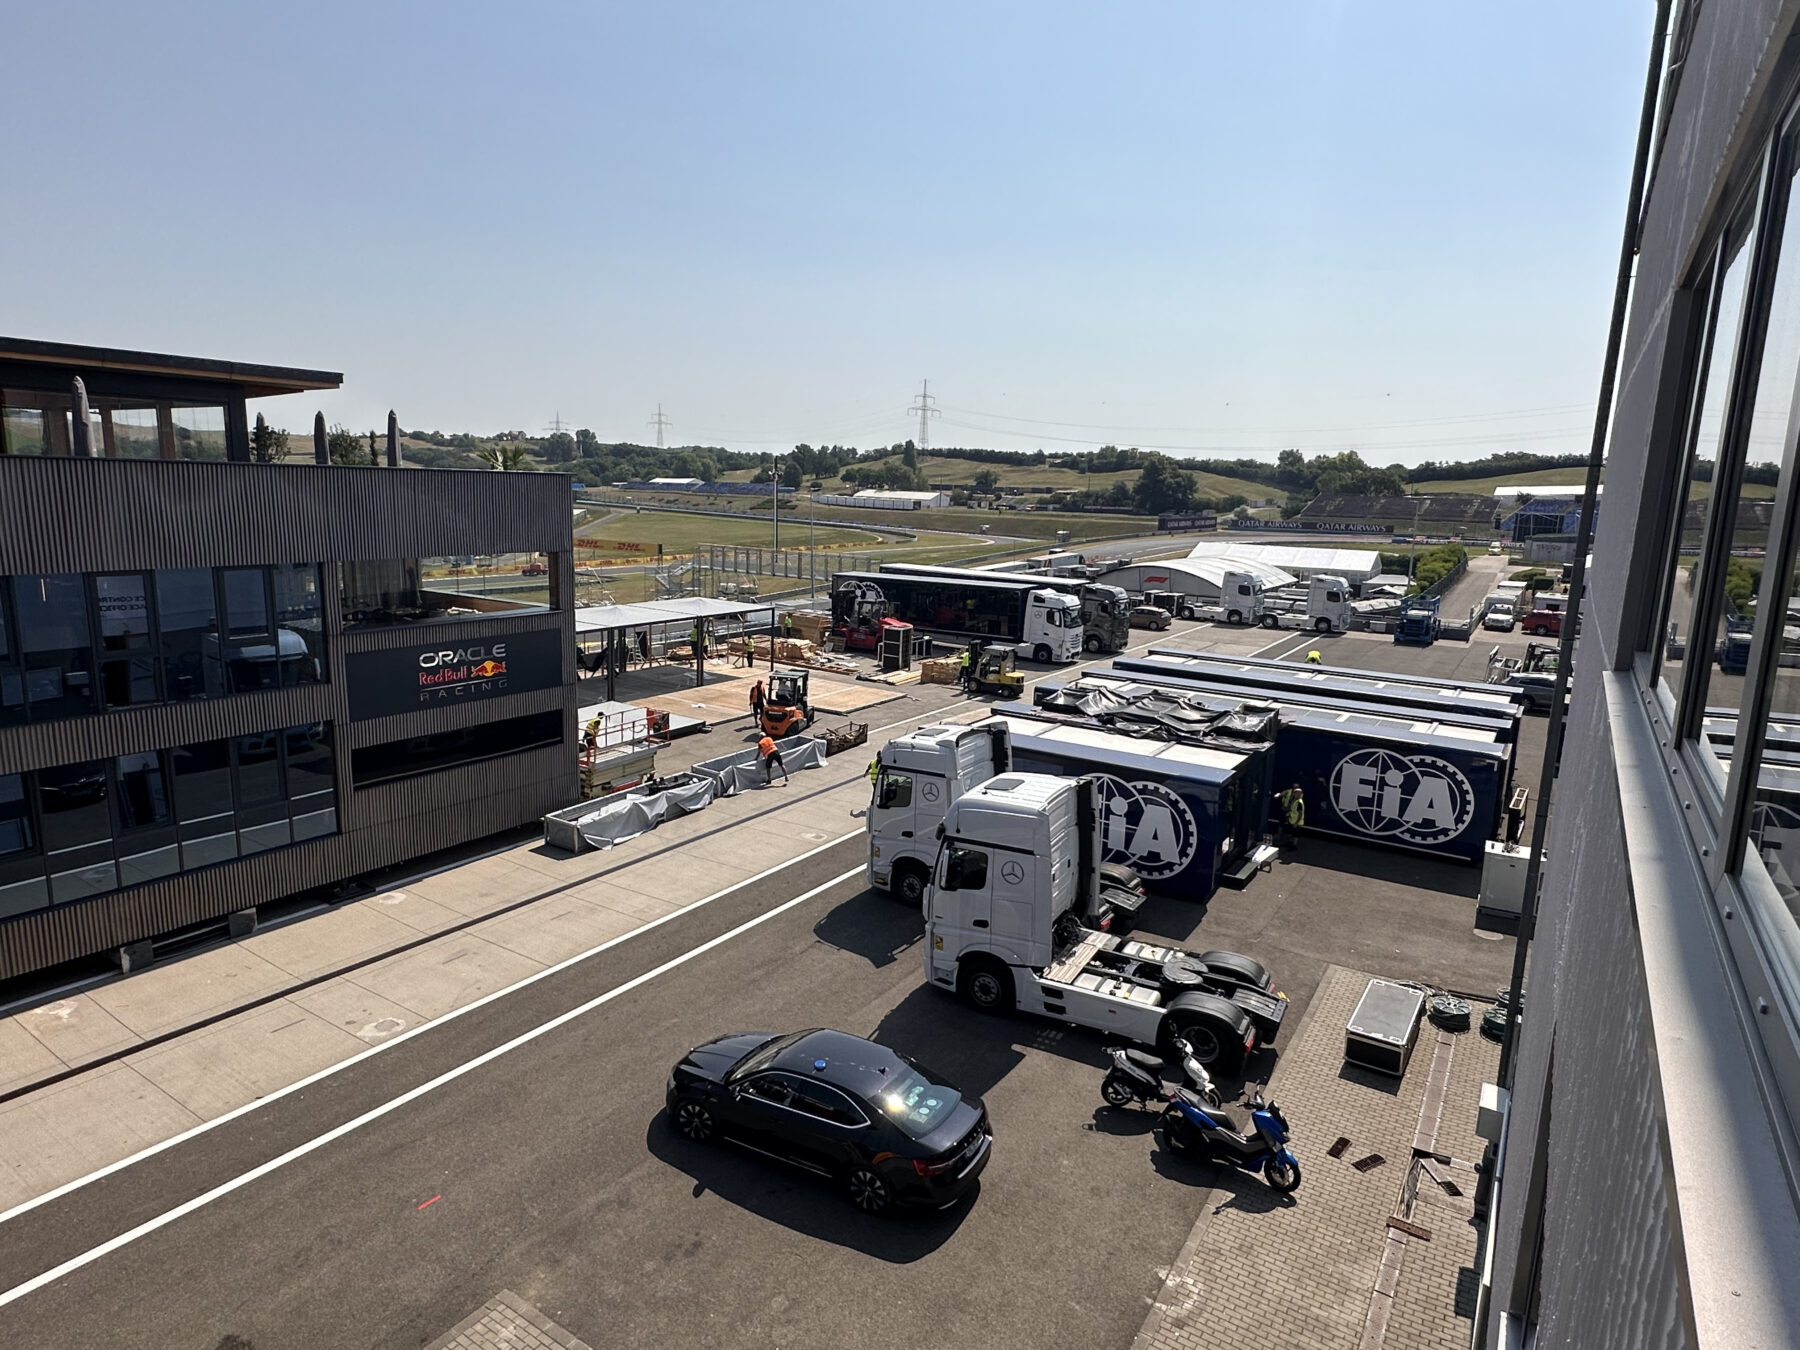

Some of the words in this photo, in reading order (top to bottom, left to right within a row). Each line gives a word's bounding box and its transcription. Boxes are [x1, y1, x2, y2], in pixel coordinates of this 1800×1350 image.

[1238, 519, 1265, 528] QATAR
[1267, 520, 1302, 529] AIRWAYS
[1316, 522, 1345, 531] QATAR
[1347, 523, 1386, 533] AIRWAYS
[616, 542, 642, 552] DHL
[419, 643, 507, 668] ORACLE
[420, 680, 508, 702] RACING
